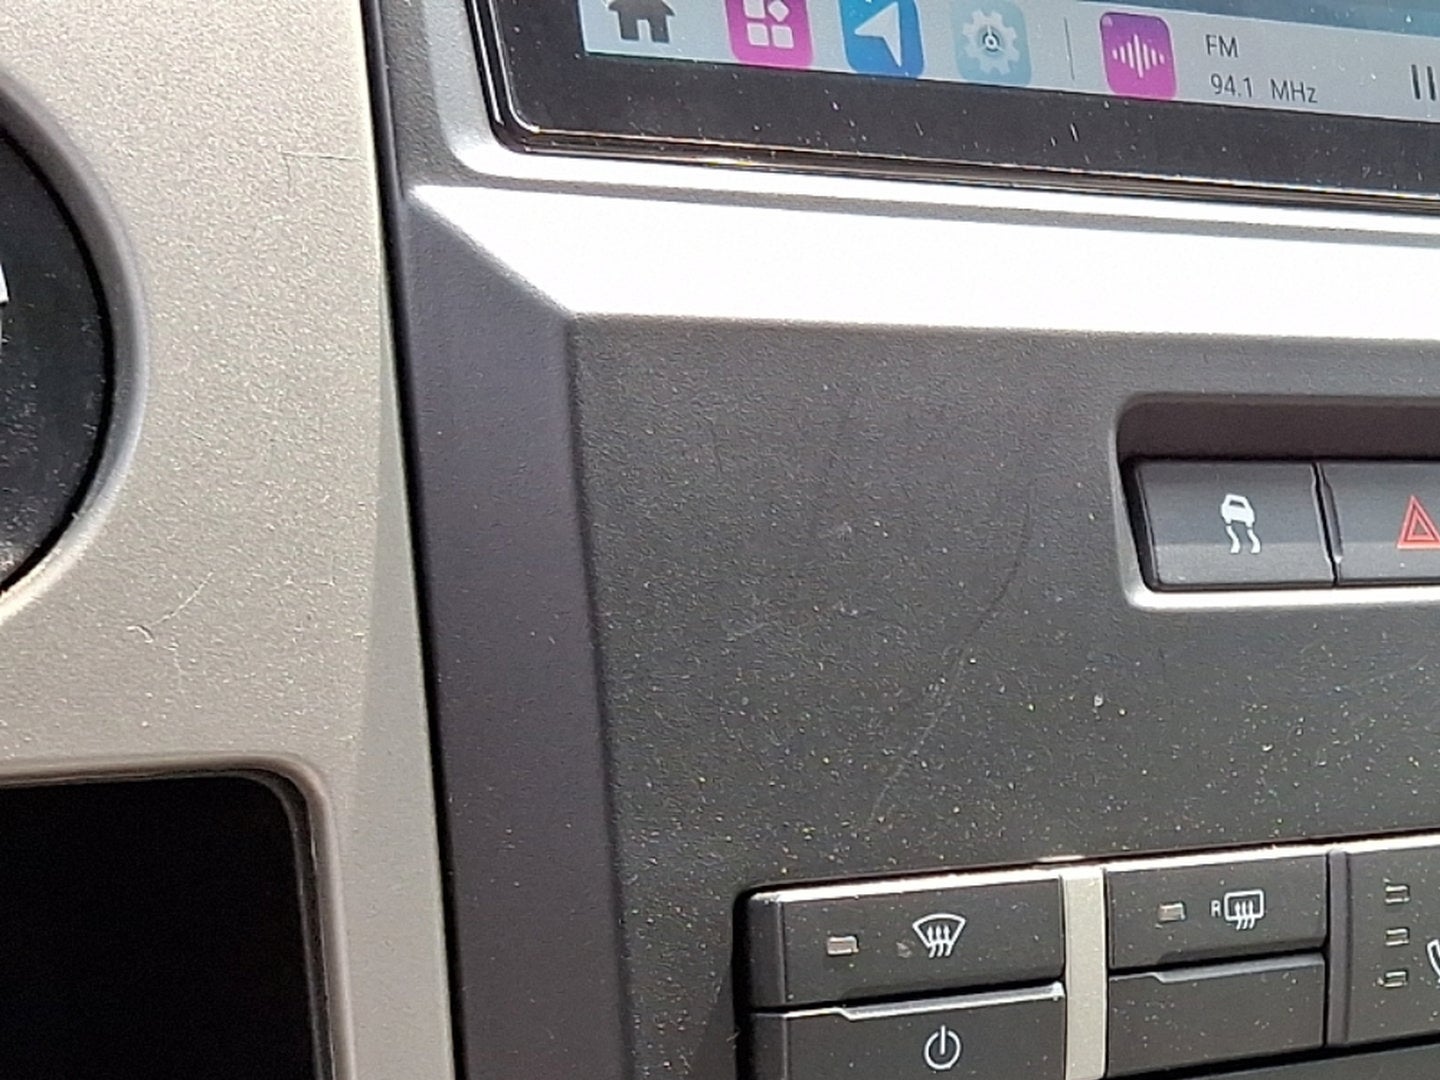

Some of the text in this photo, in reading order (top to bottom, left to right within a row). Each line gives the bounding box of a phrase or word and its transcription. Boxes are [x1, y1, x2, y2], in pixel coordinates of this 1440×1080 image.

[1205, 34, 1239, 58] FM
[1210, 73, 1318, 103] 94.1 MHz
